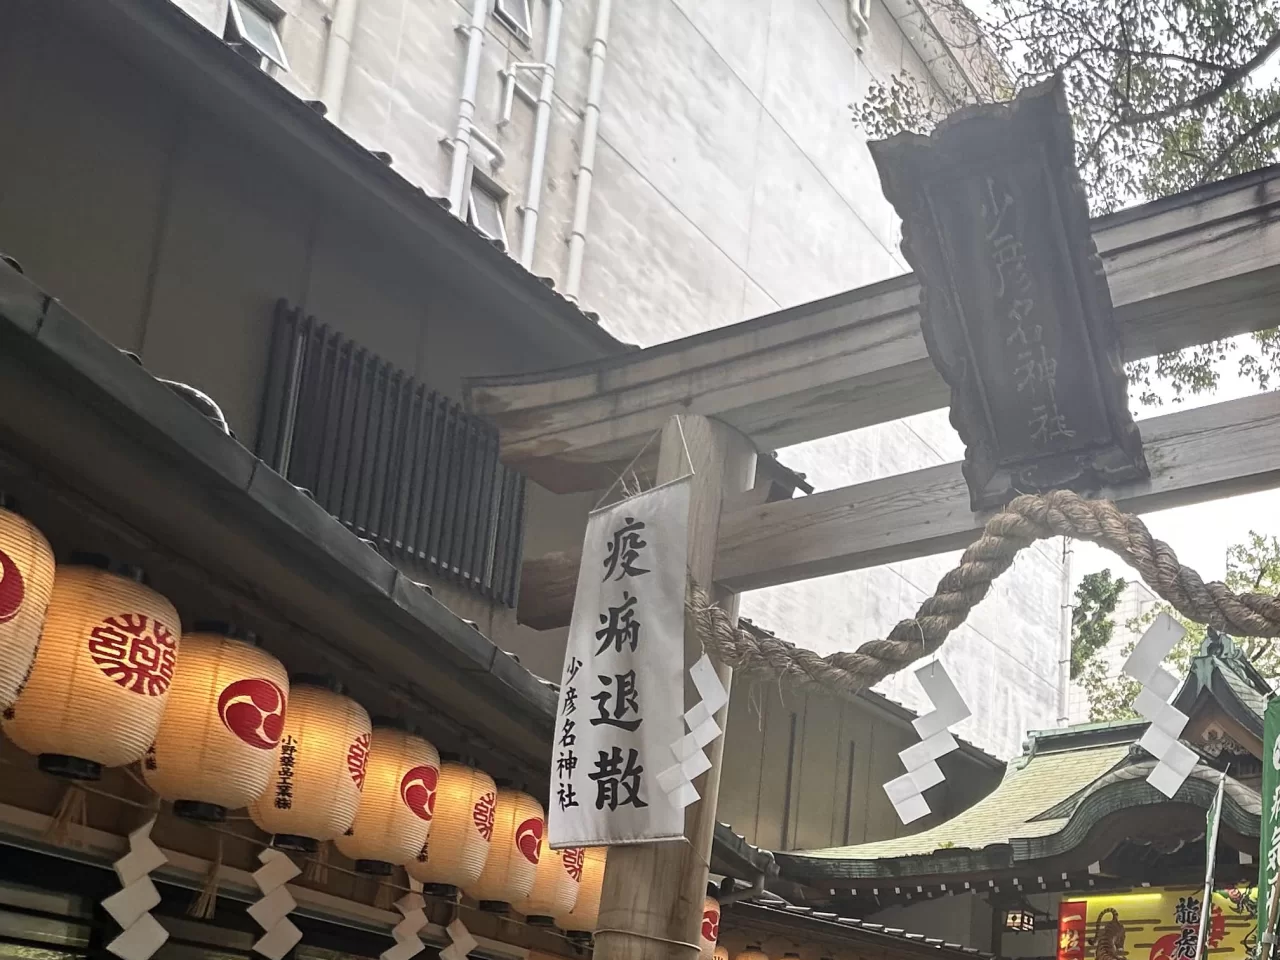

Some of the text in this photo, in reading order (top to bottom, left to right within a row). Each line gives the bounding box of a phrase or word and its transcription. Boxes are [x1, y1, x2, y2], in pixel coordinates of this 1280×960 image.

[556, 656, 583, 813] 少彦名神社
[587, 517, 651, 811] 疫病退散
